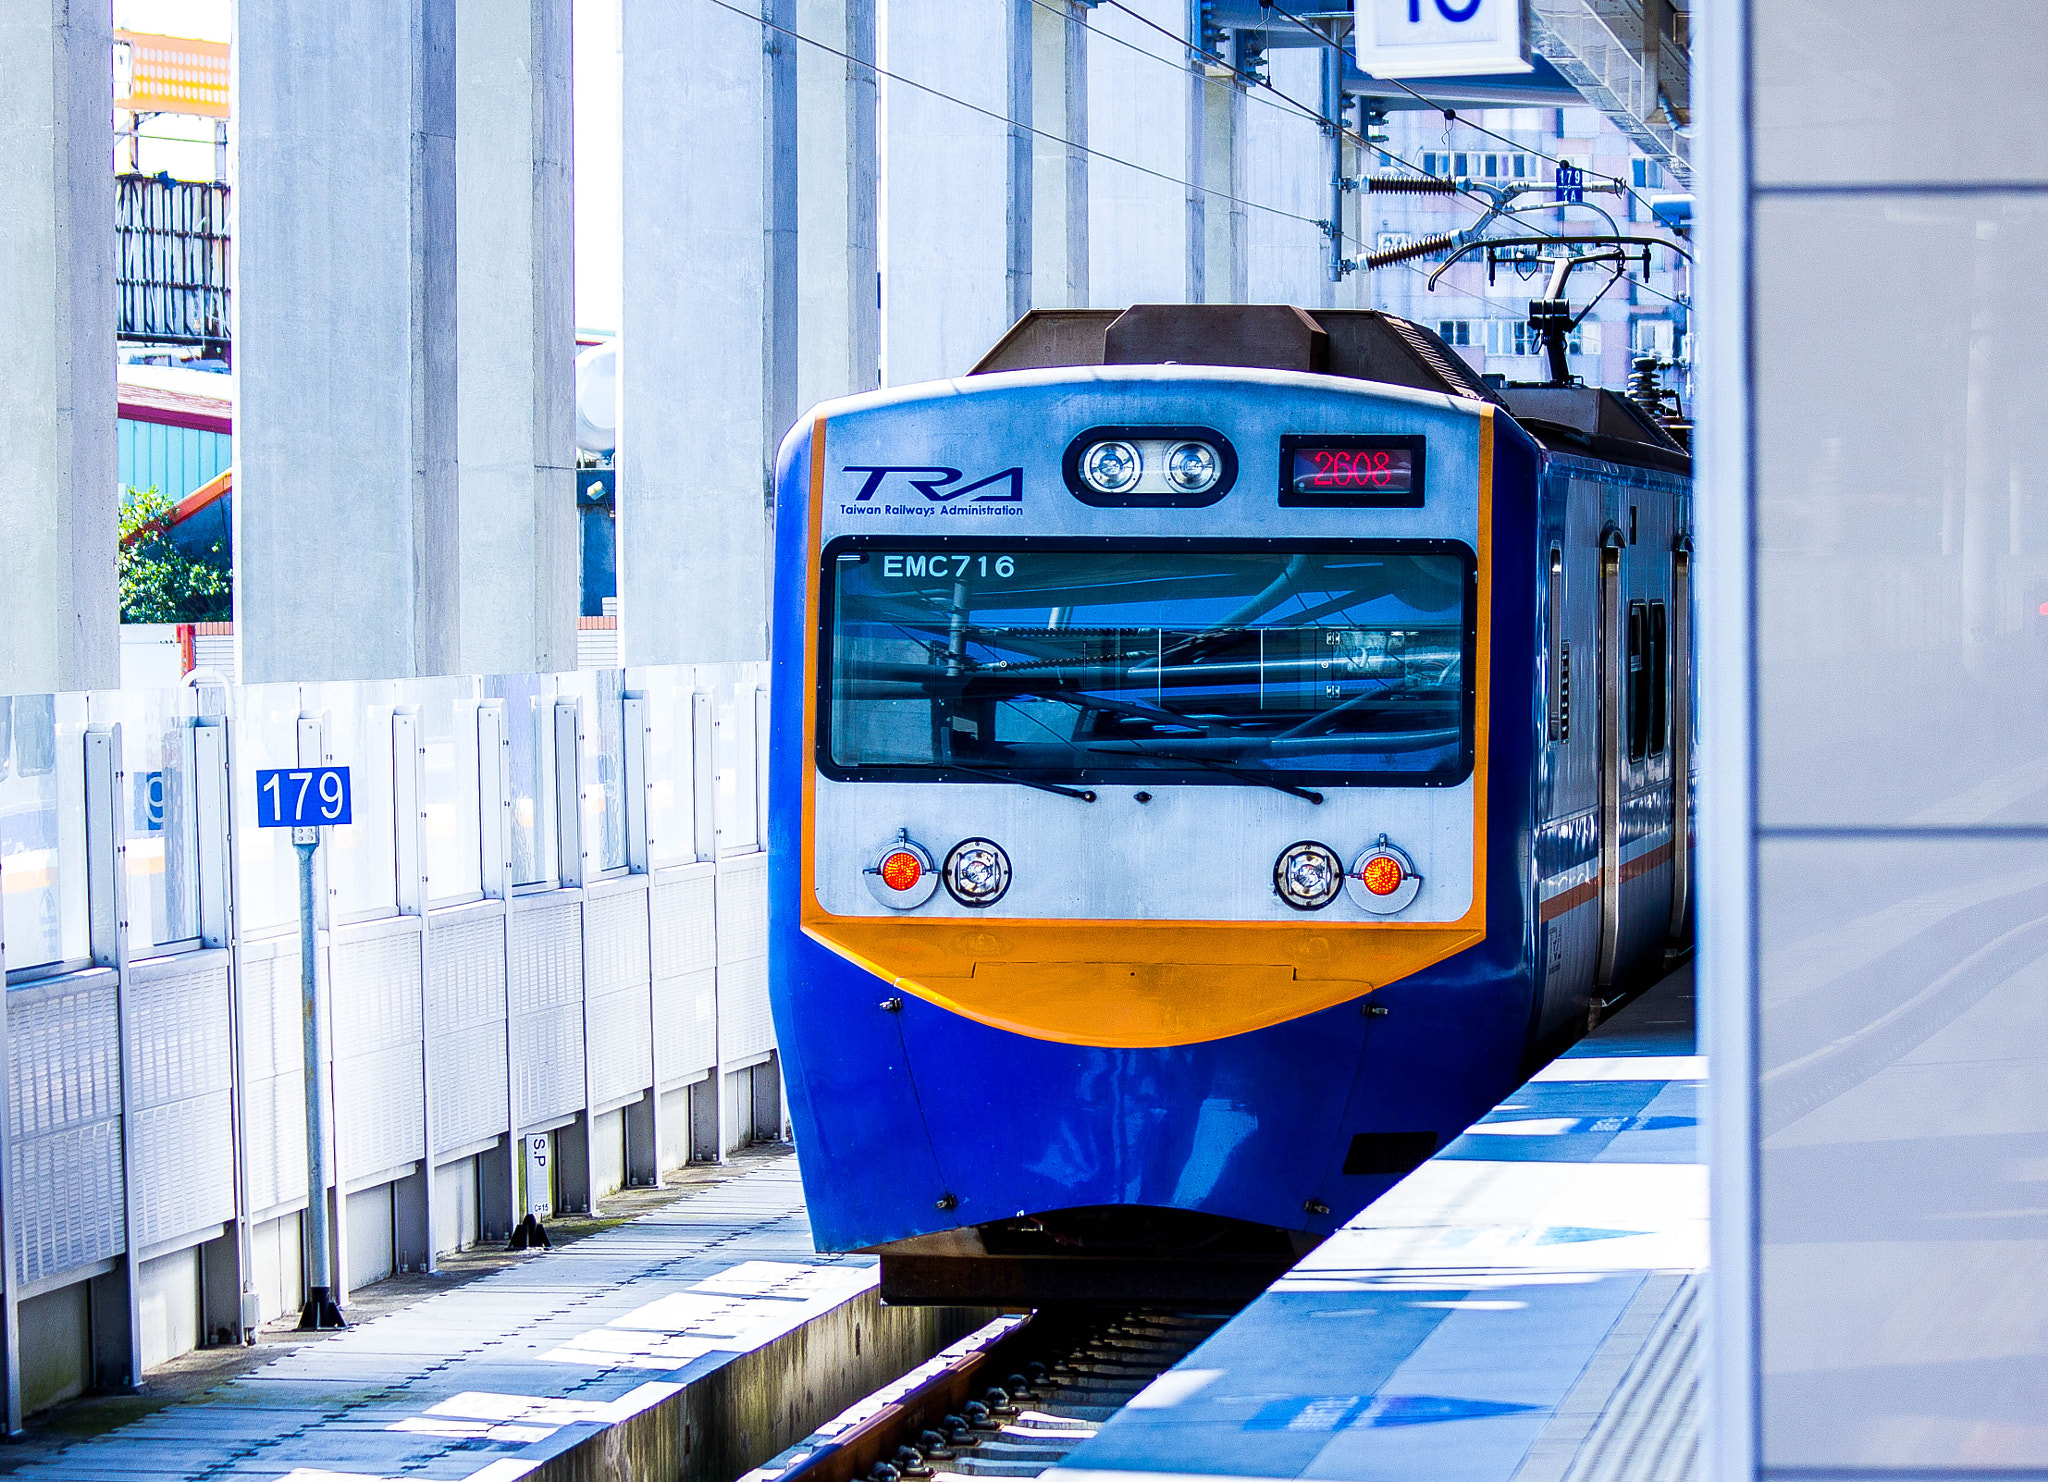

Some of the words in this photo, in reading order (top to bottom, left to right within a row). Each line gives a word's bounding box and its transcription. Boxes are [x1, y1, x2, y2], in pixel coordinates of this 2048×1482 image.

[1560, 170, 1581, 184] 179
[1314, 451, 1392, 486] 2608
[842, 466, 1024, 502] TRA
[840, 504, 882, 516] Taiwan
[885, 504, 936, 518] Railways
[940, 505, 1024, 517] Administration
[883, 555, 1016, 578] EMC716
[263, 771, 344, 822] 179
